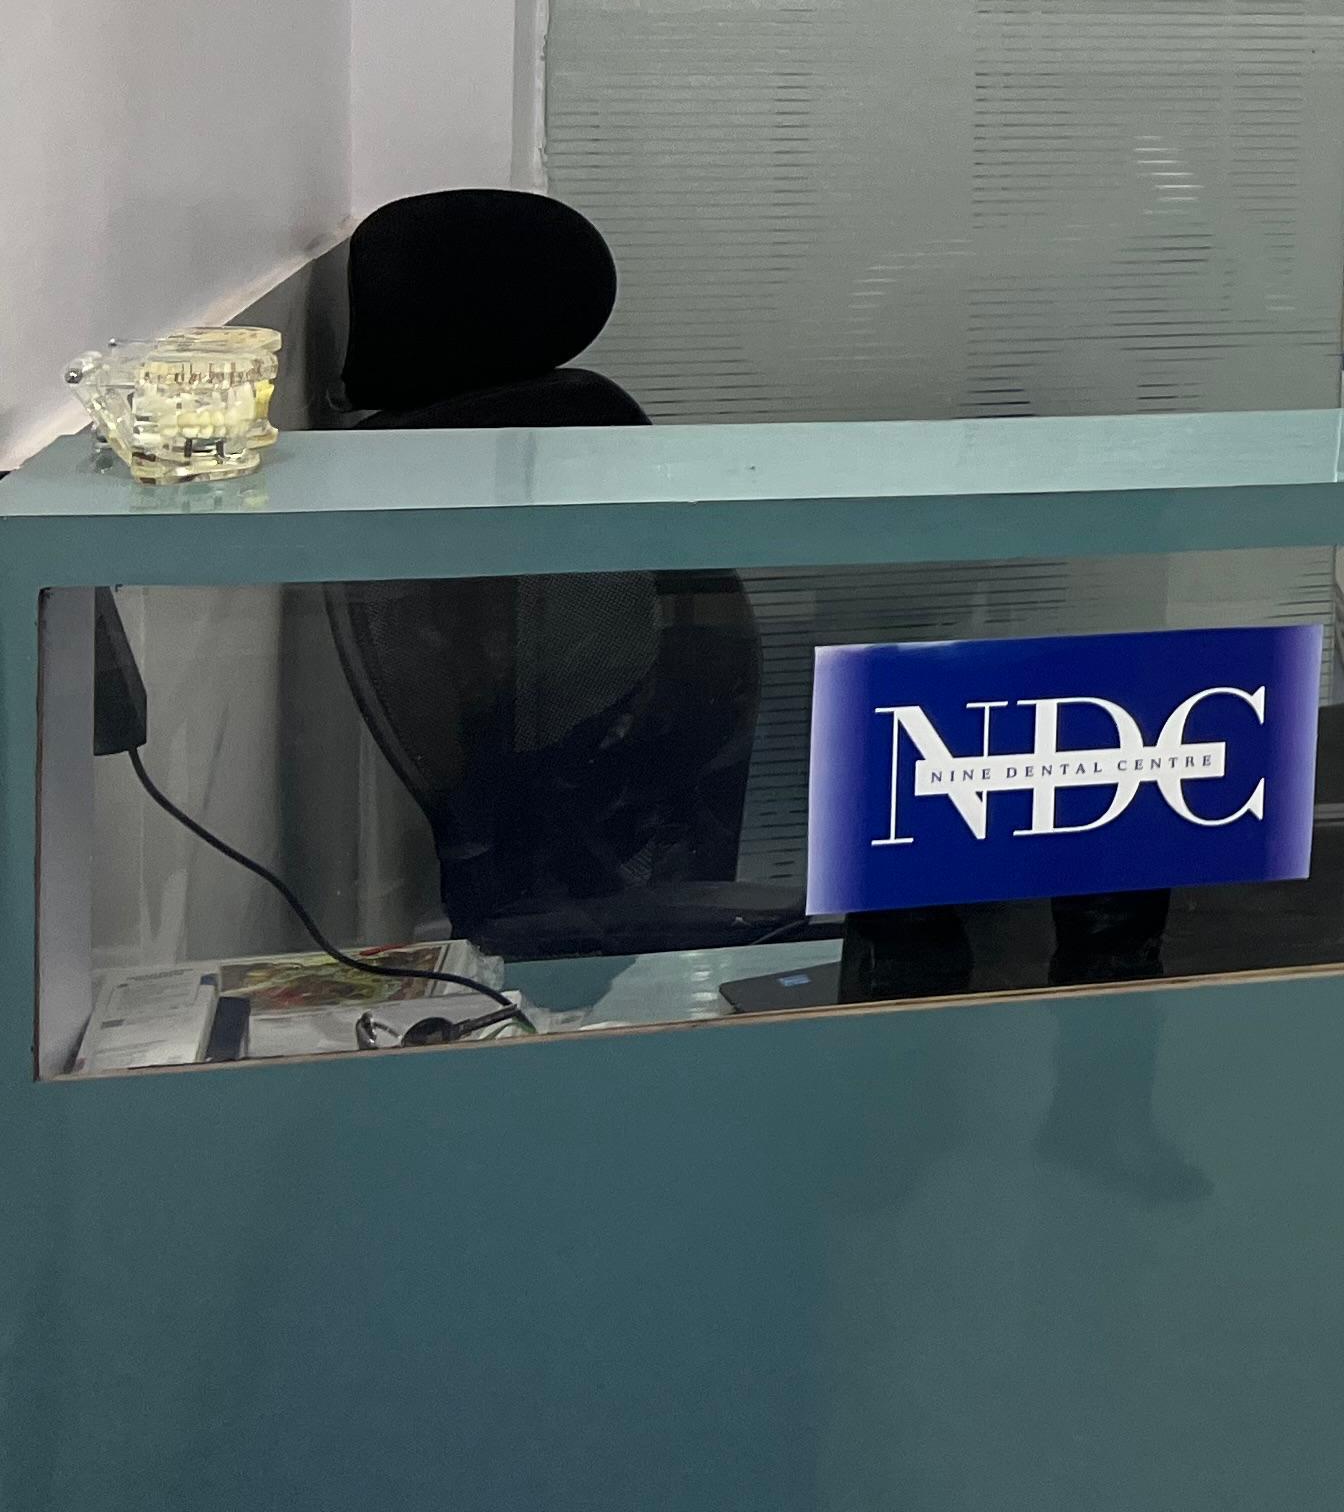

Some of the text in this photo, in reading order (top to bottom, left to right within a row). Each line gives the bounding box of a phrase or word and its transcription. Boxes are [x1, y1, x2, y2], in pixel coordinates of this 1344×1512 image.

[871, 685, 1266, 846] NDC
[931, 752, 1214, 784] NINE DENTAL CENTRE
